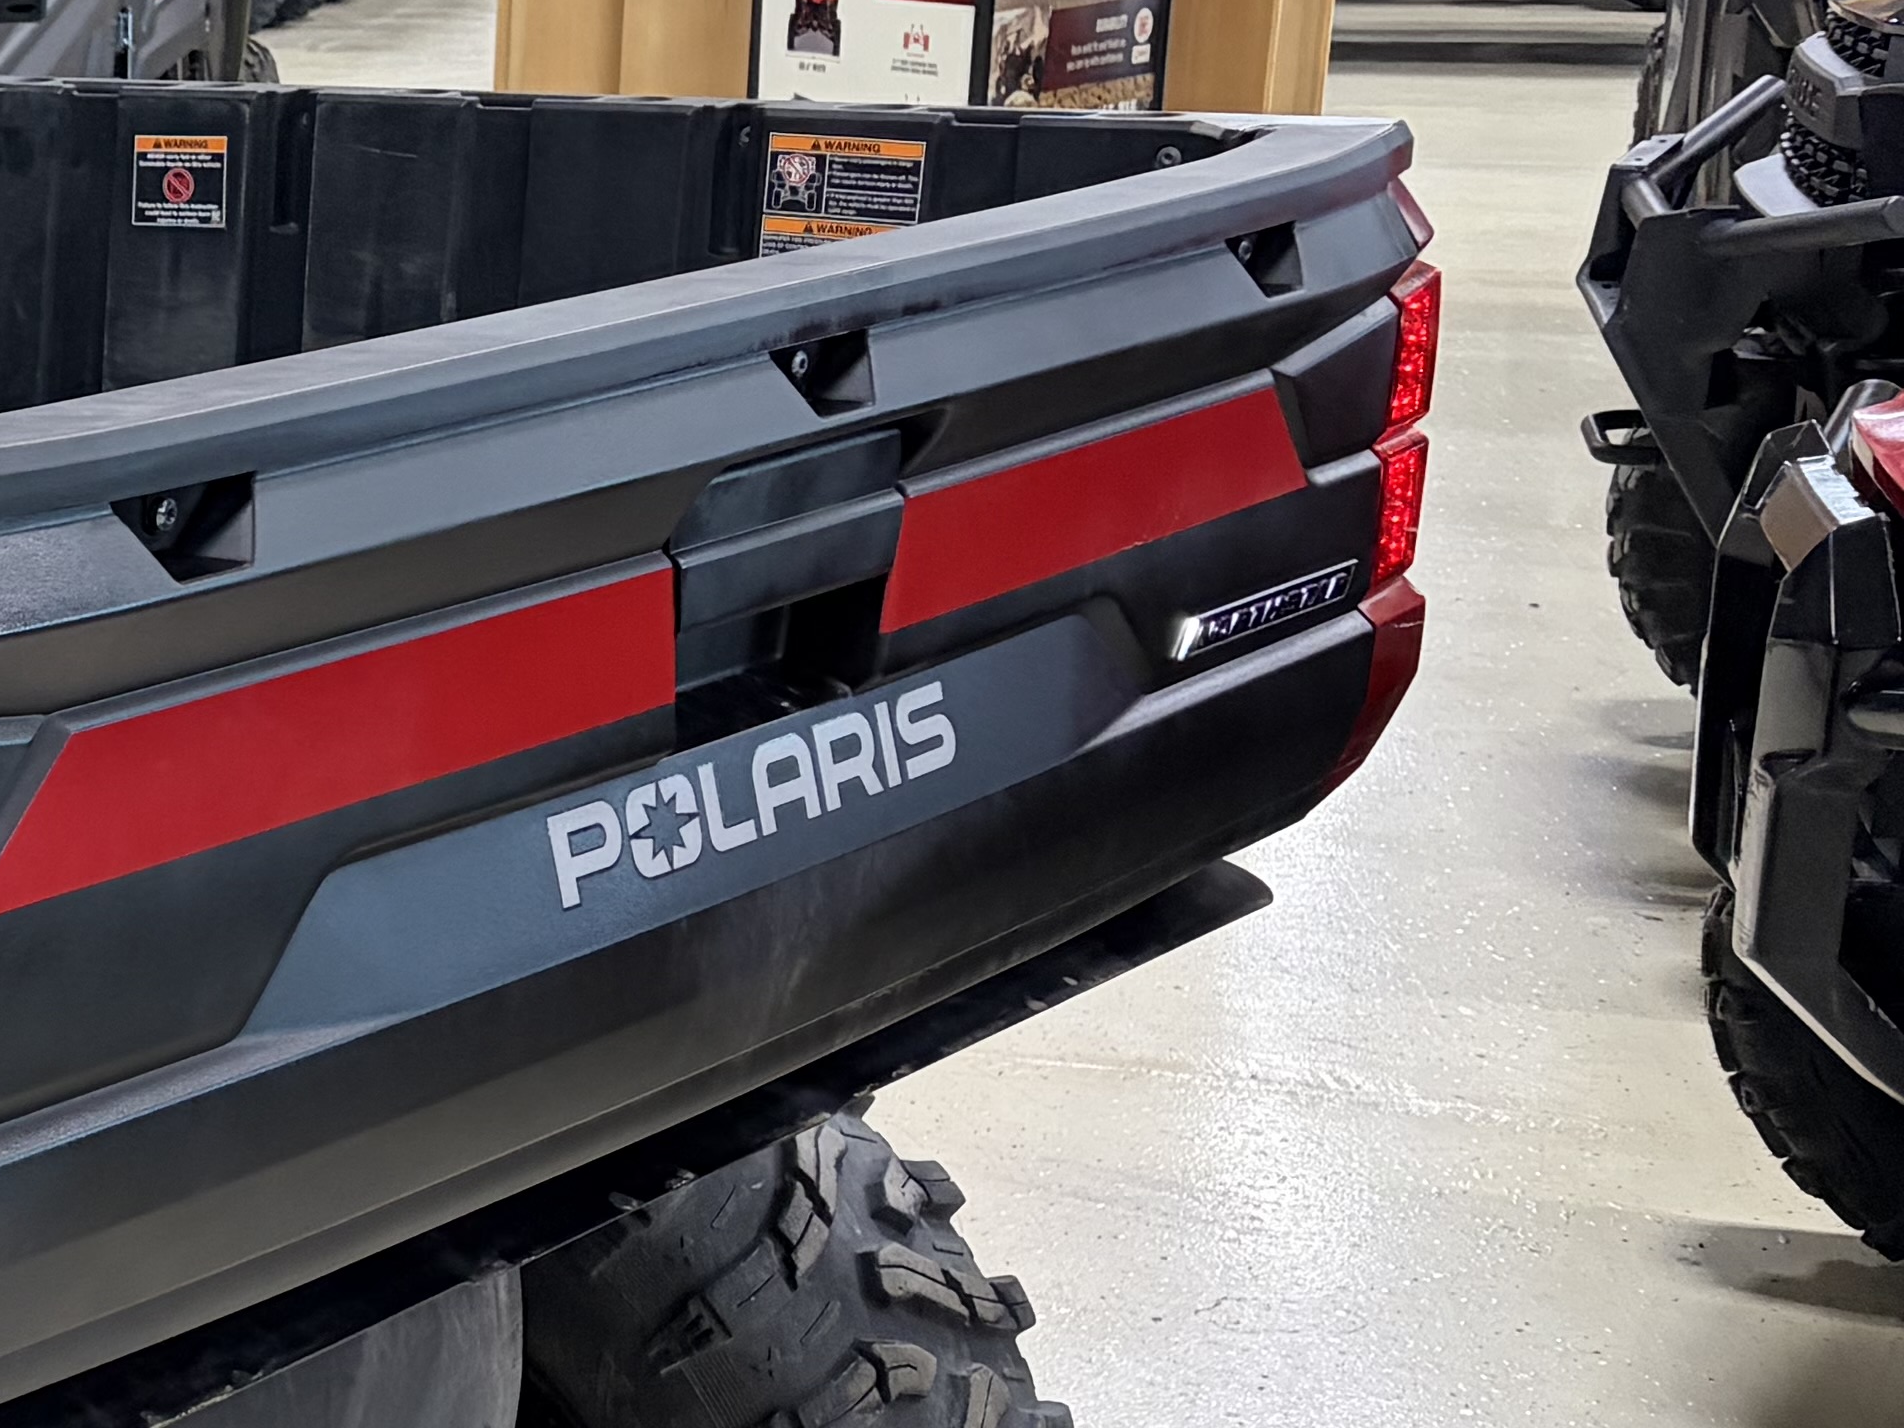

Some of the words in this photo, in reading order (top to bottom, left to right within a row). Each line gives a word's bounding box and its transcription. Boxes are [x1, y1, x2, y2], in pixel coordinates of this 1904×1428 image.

[163, 139, 208, 149] WARNING
[824, 140, 881, 153] WARNING
[547, 680, 957, 909] POLARIS
